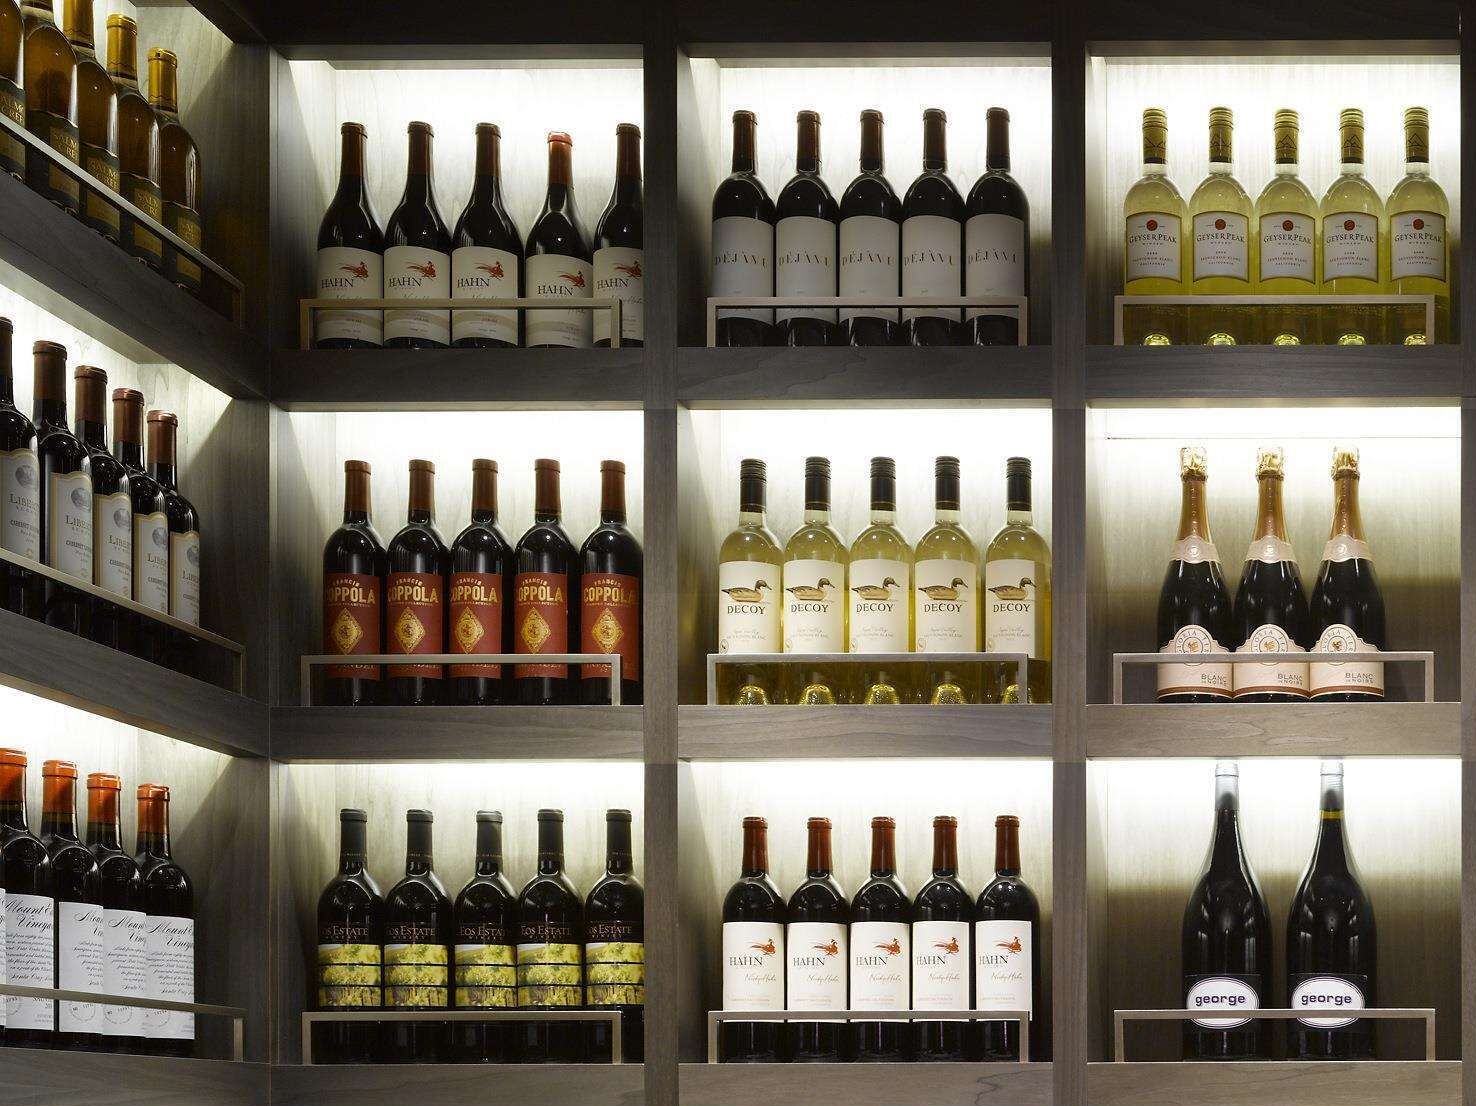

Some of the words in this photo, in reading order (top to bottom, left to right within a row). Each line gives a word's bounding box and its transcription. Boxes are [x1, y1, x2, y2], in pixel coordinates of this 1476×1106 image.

[321, 276, 354, 289] HAHN
[388, 275, 422, 289] HAHN
[457, 276, 490, 289] HAHN
[597, 277, 629, 290] HAHN
[537, 284, 573, 297] HAHN
[727, 604, 766, 615] DECOY
[790, 603, 829, 614] DECOY
[856, 603, 894, 613] DECOY
[924, 603, 963, 613] DECOY
[993, 603, 1031, 613] DECOY
[729, 957, 763, 967] HAHN
[793, 957, 826, 967] HAHN
[856, 956, 888, 966] HAHN
[915, 955, 947, 965] HAHN
[979, 955, 1009, 965] HAHN
[1195, 995, 1246, 1007] george
[1301, 994, 1352, 1006] george
